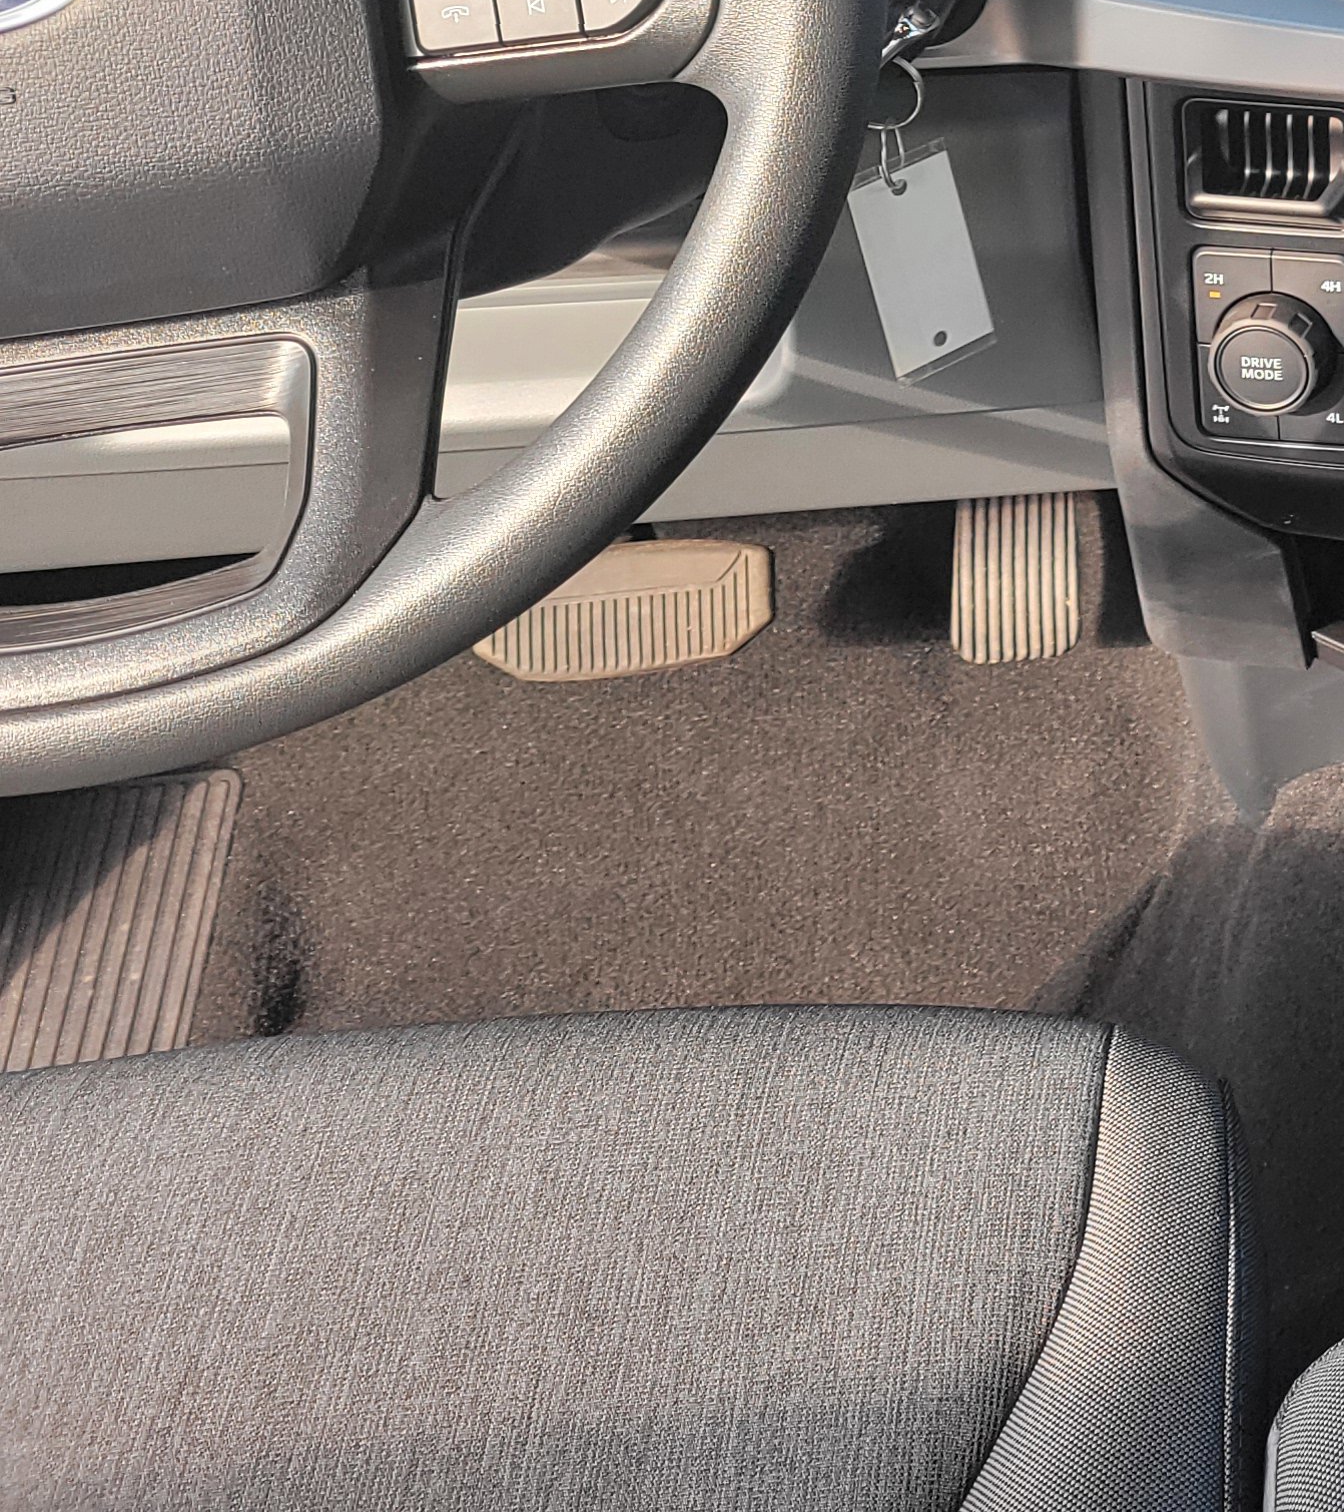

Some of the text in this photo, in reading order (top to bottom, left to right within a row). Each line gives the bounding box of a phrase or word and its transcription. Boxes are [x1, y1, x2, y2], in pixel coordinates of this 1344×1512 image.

[1204, 273, 1224, 285] 2H
[1320, 280, 1341, 293] 4H
[1241, 356, 1283, 369] DRIVE
[1241, 368, 1283, 381] MODE
[1326, 412, 1344, 424] 4L
